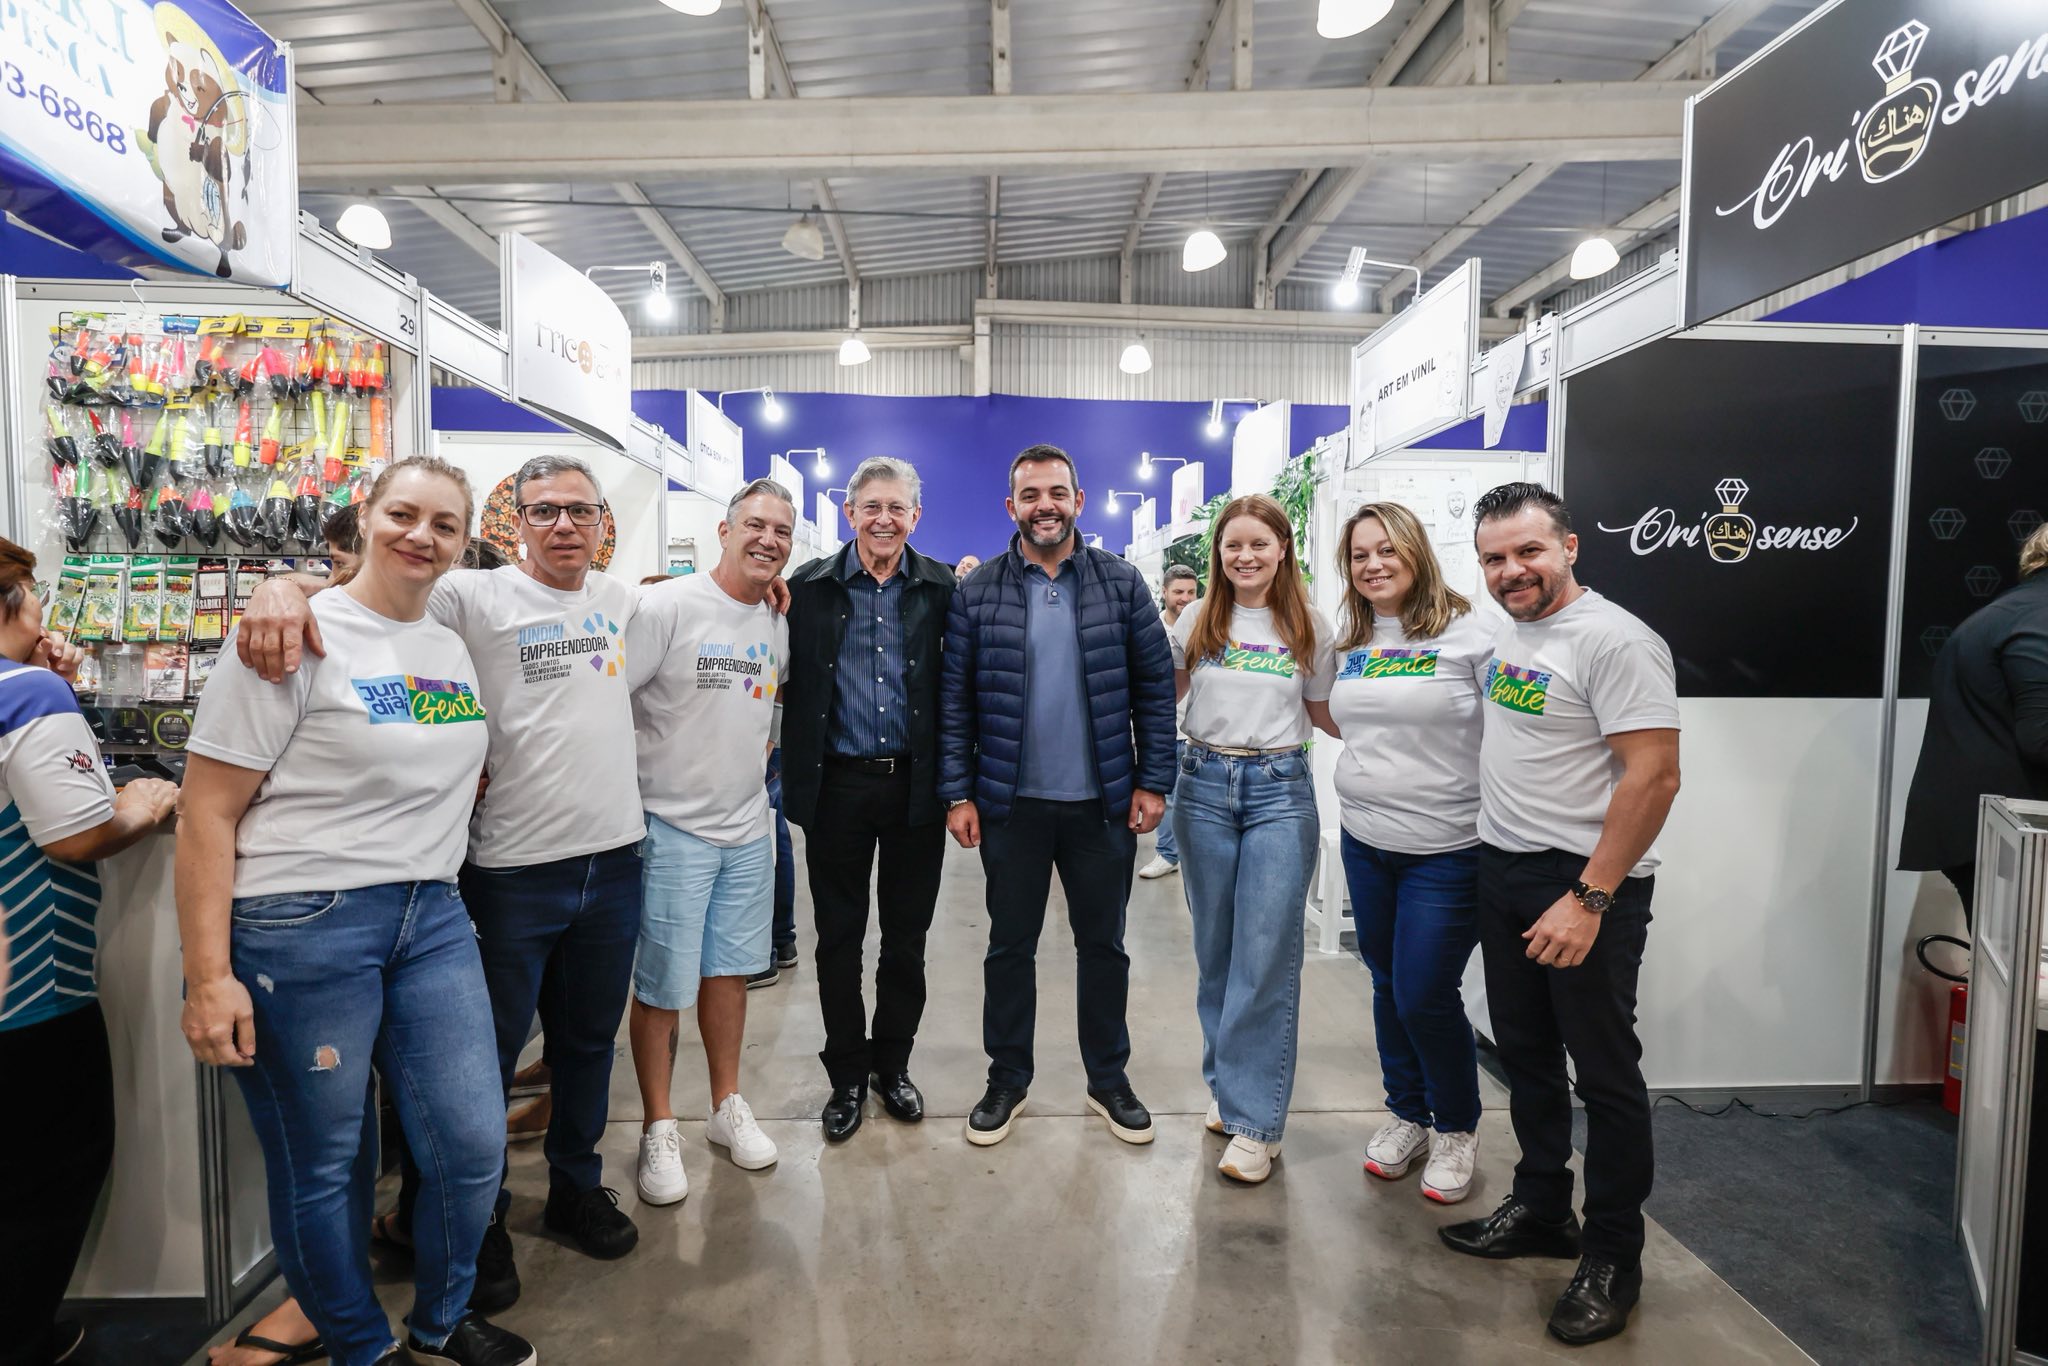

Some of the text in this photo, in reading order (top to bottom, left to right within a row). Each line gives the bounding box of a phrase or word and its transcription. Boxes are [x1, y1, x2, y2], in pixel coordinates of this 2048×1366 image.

[1941, 33, 2048, 126] sen
[0, 61, 127, 155] 3-6868
[399, 314, 415, 336] 29
[1378, 357, 1436, 402] ART EM VINIL
[1755, 516, 1859, 551] sense
[200, 598, 222, 609] SABIKI
[520, 636, 610, 663] EMPREENDEDORA
[1222, 649, 1296, 674] Gente
[522, 658, 560, 671] TODOS JUNTOS
[523, 664, 572, 677] PARA MOVIMENTAR
[696, 657, 762, 676] EMPREENDEDORA
[1361, 657, 1437, 679] Gente
[524, 671, 571, 684] NOSSA ECONOMIA
[1488, 674, 1550, 711] Gente
[411, 690, 487, 724] Gente
